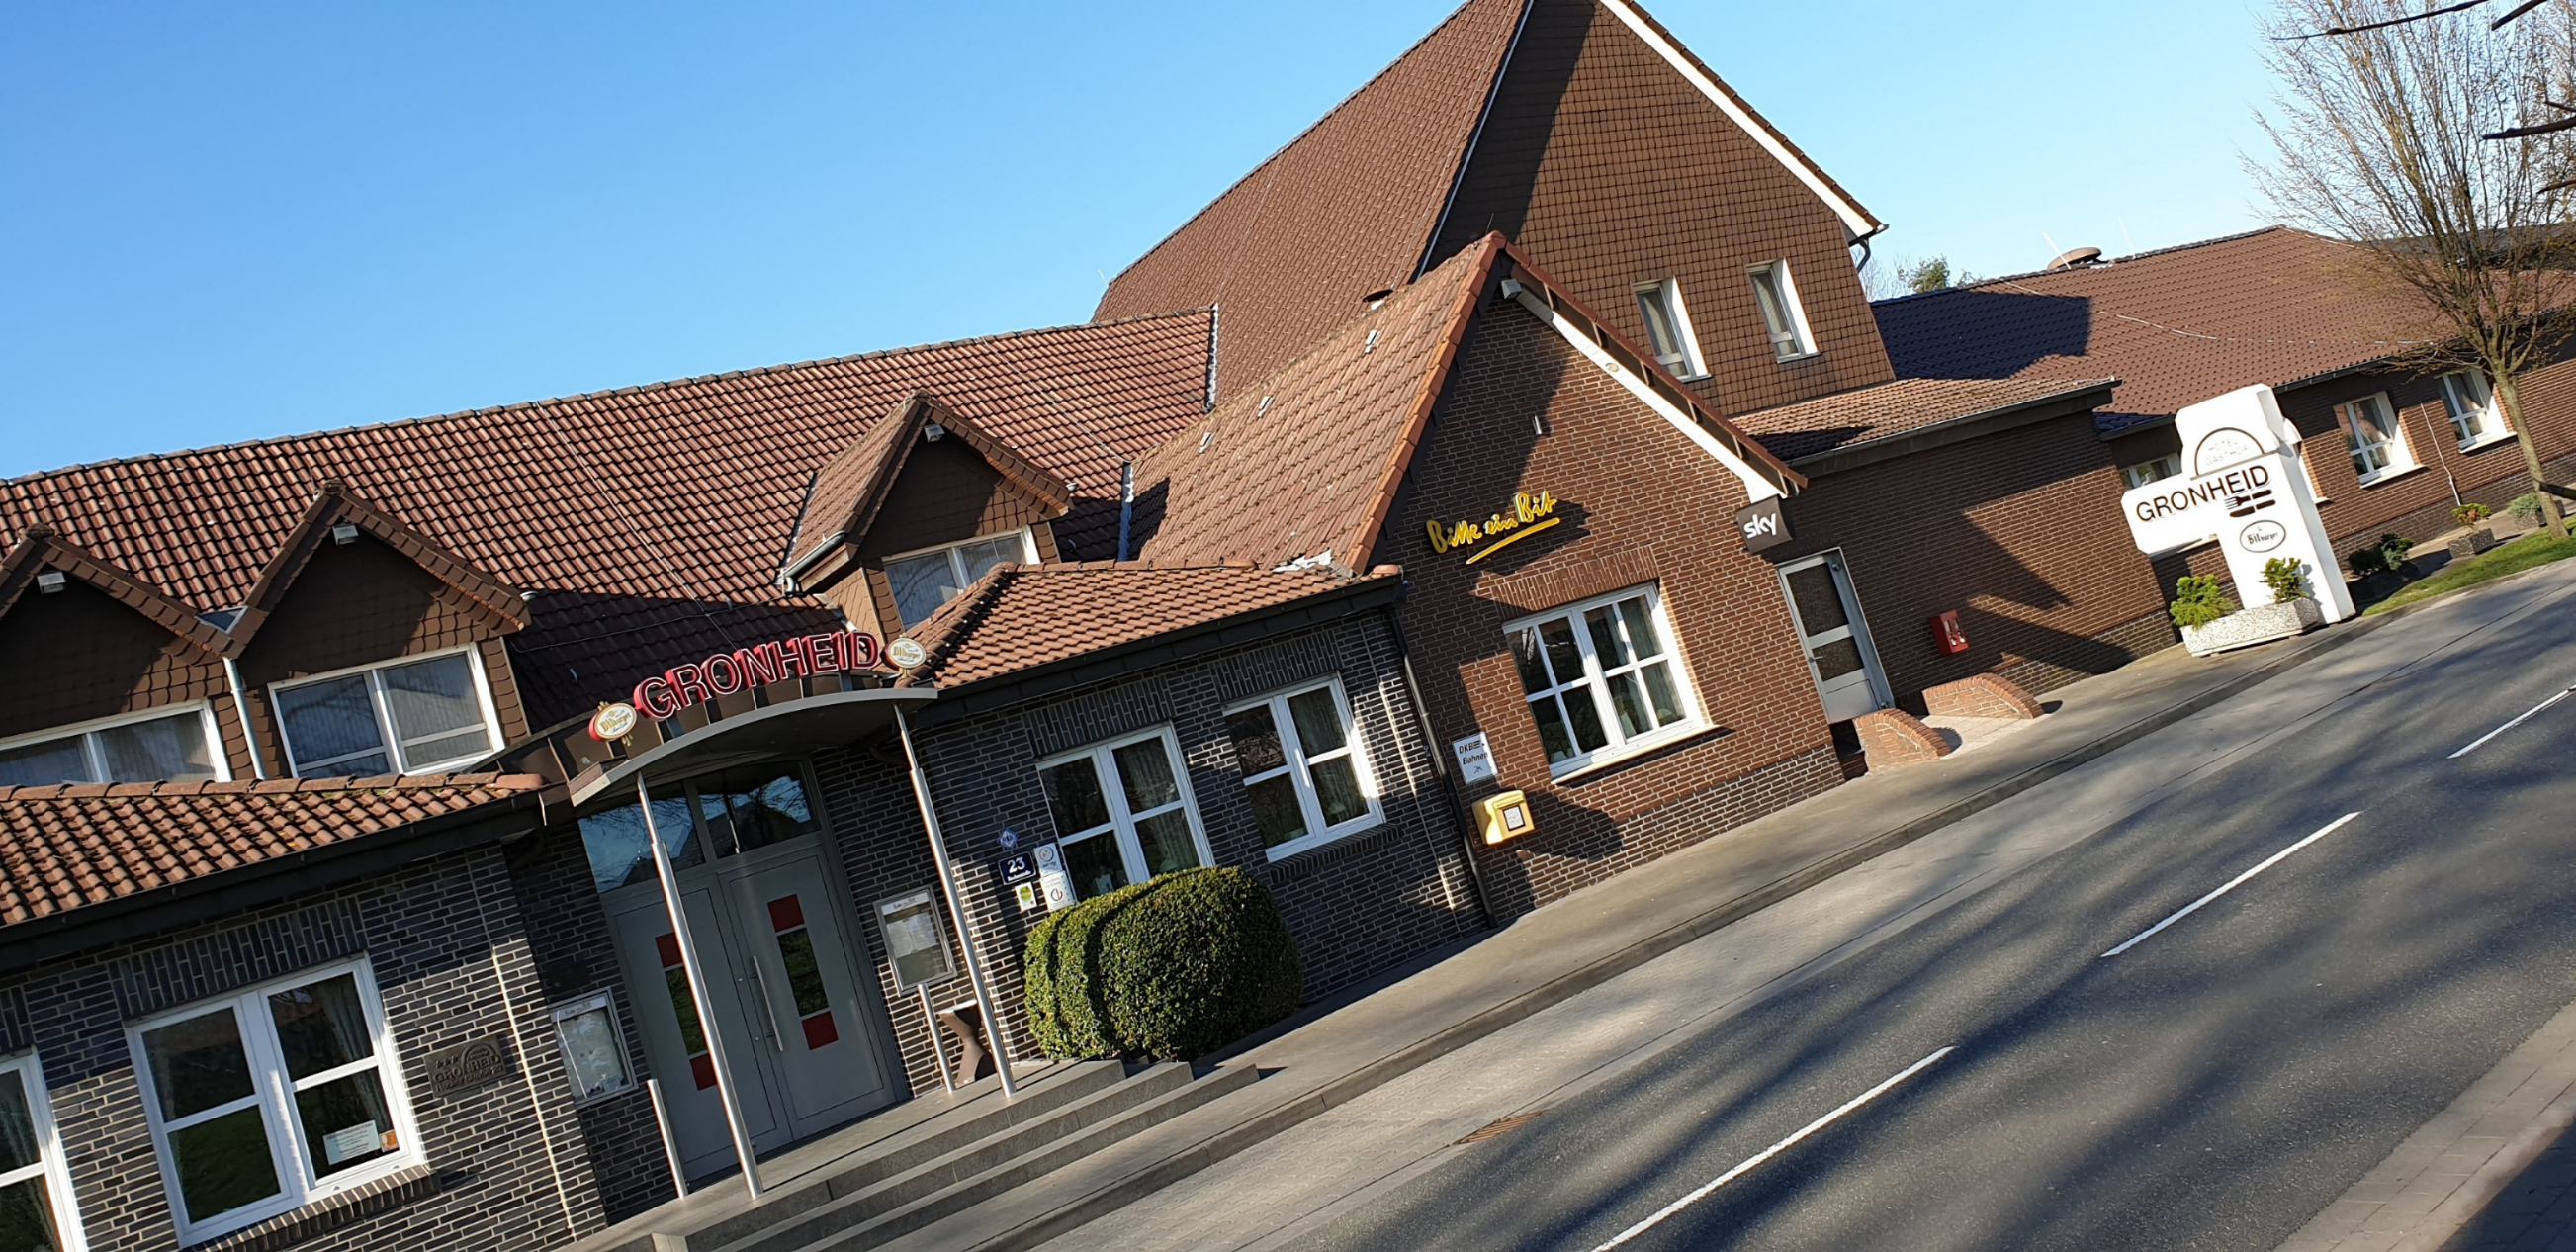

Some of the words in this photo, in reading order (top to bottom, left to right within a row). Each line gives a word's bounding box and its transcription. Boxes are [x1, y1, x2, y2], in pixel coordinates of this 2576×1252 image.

[2136, 465, 2269, 521] GRONHEID
[1426, 519, 1482, 553] Bitte
[1483, 514, 1519, 535] ein
[1514, 491, 1557, 523] Bit
[1743, 513, 1777, 539] sky
[634, 631, 879, 721] GRONHEID
[1463, 752, 1488, 764] Bahnen
[1007, 856, 1025, 873] 23
[433, 1054, 501, 1083] GRONHEID
